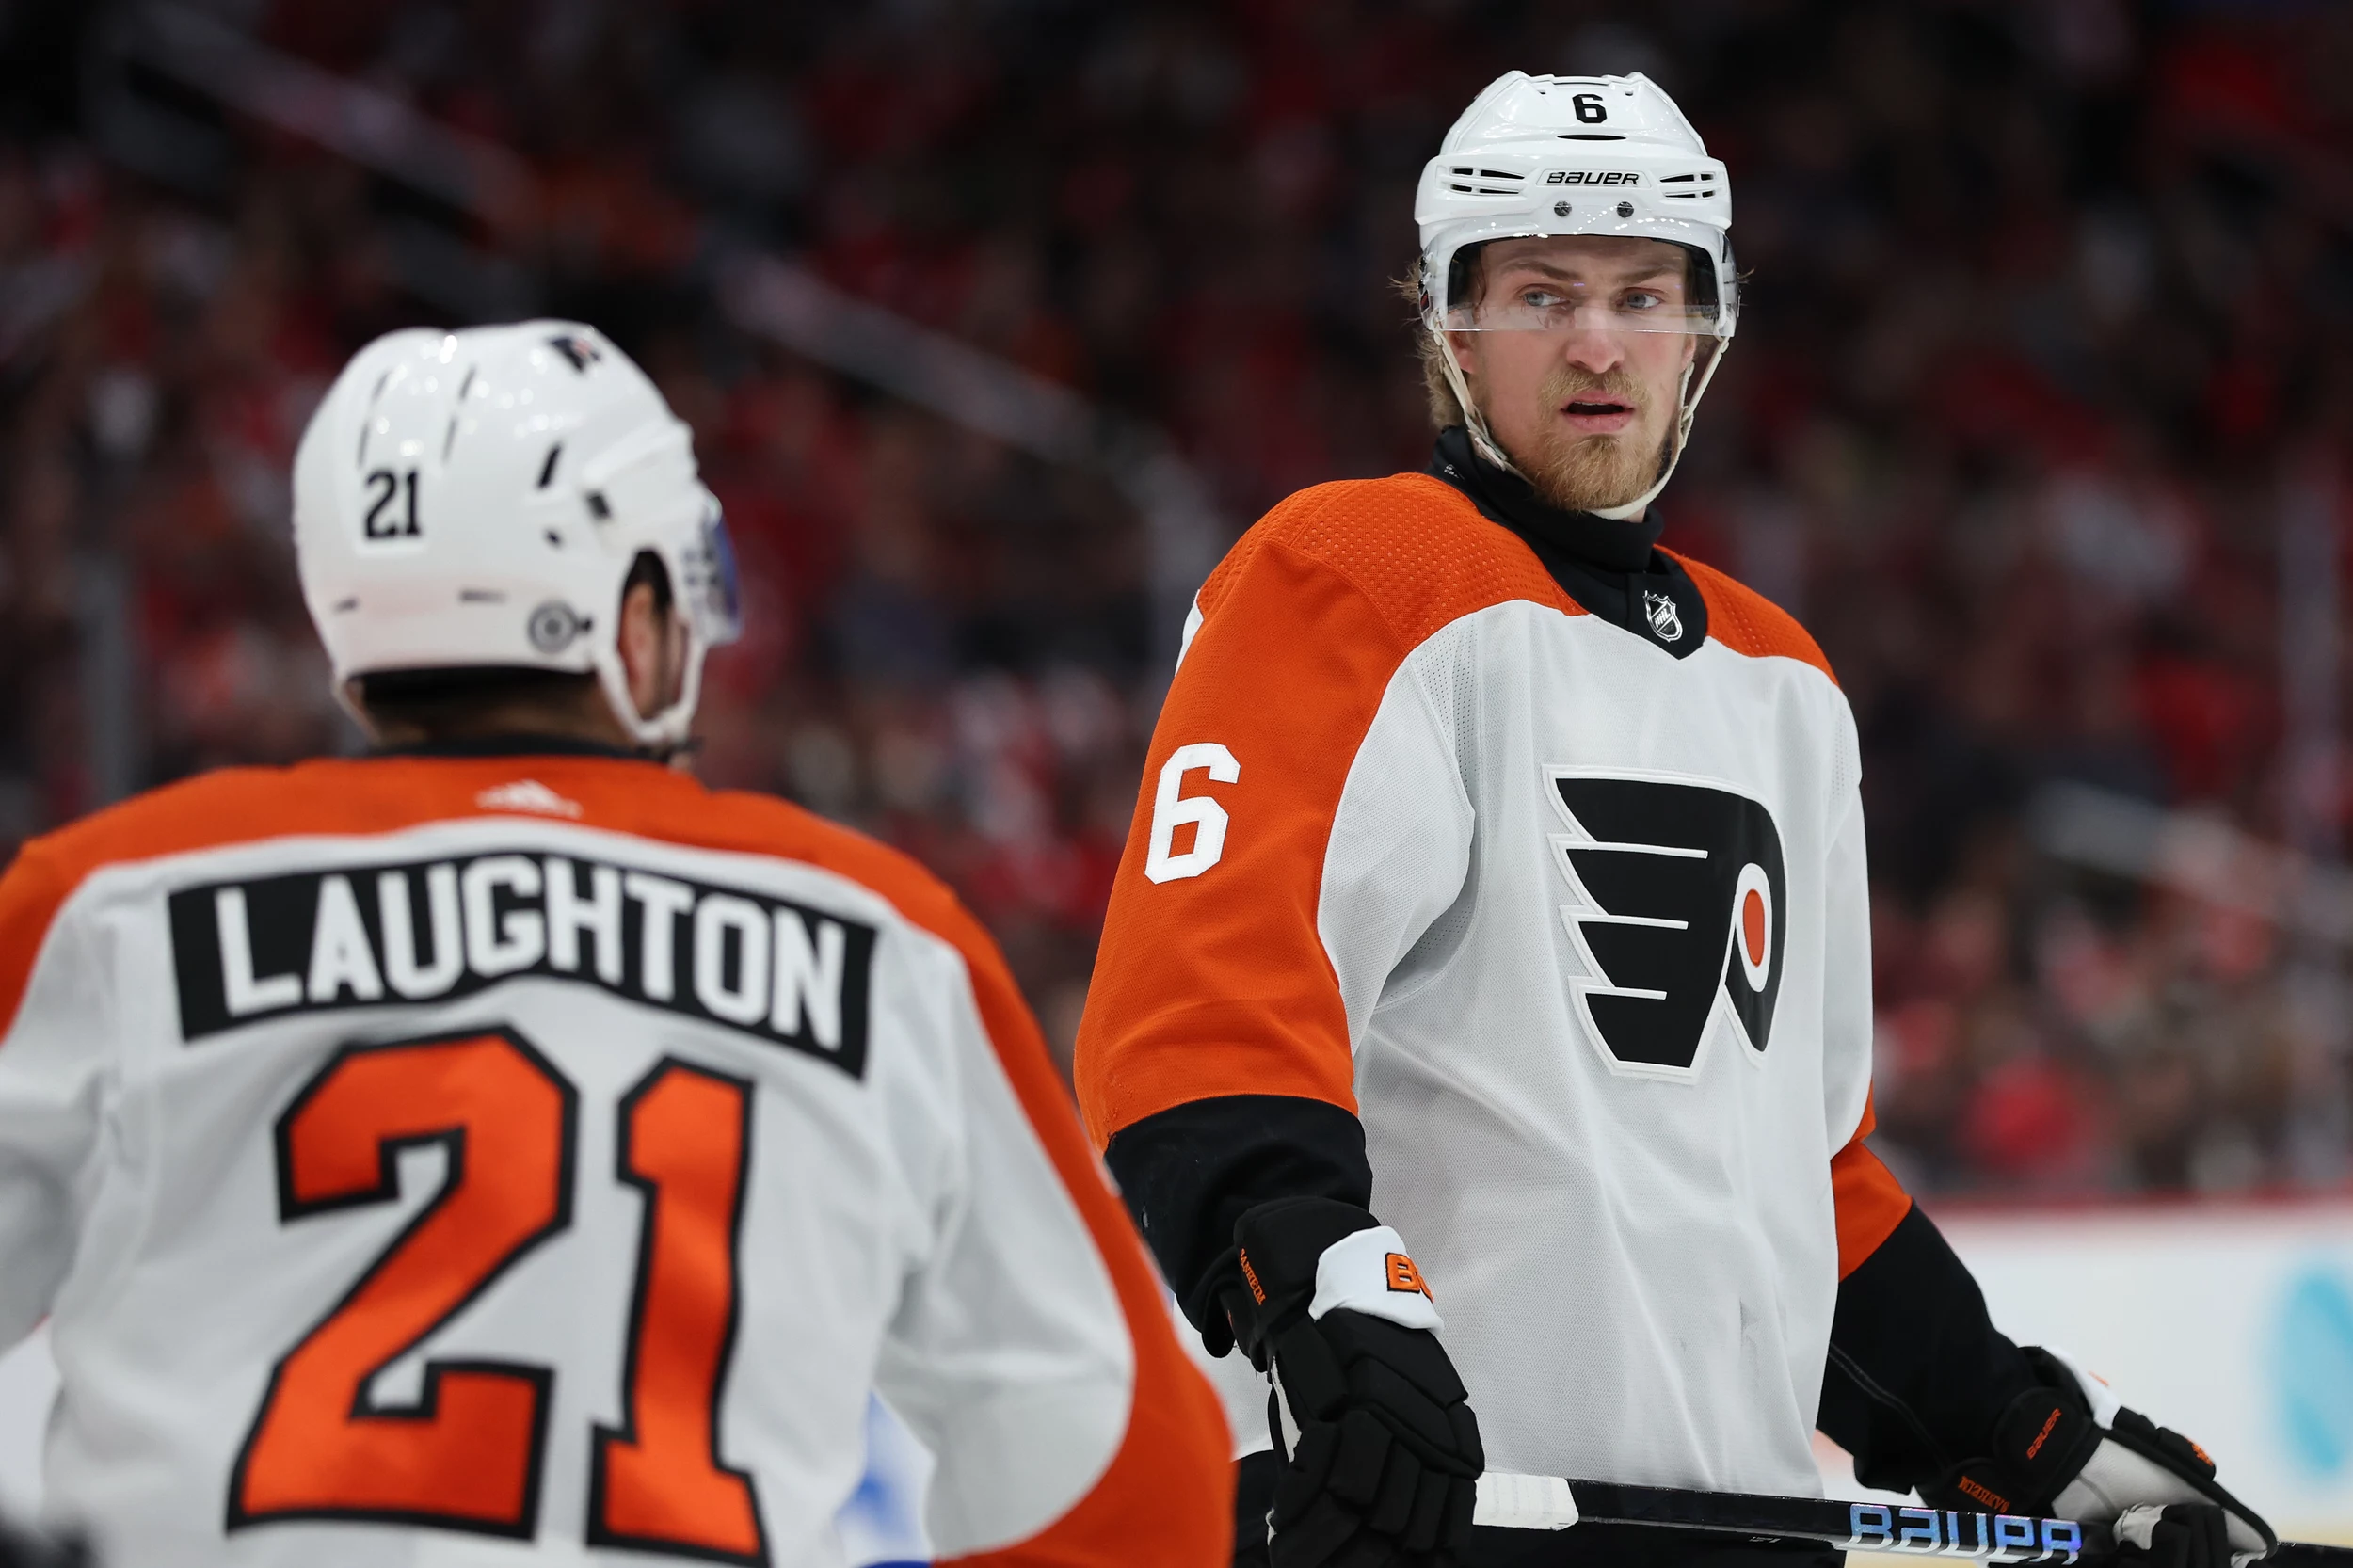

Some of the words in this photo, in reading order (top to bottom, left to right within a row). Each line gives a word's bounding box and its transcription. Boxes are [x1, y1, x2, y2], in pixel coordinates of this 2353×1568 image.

[1573, 93, 1607, 123] 6
[1546, 171, 1639, 184] BAUER
[363, 470, 423, 540] 21
[1144, 742, 1241, 885] 6
[216, 855, 846, 1051] LAUGHTON
[225, 1023, 774, 1566] 21
[2026, 1408, 2061, 1460] BAUER
[1838, 1503, 2082, 1565] BAUER
